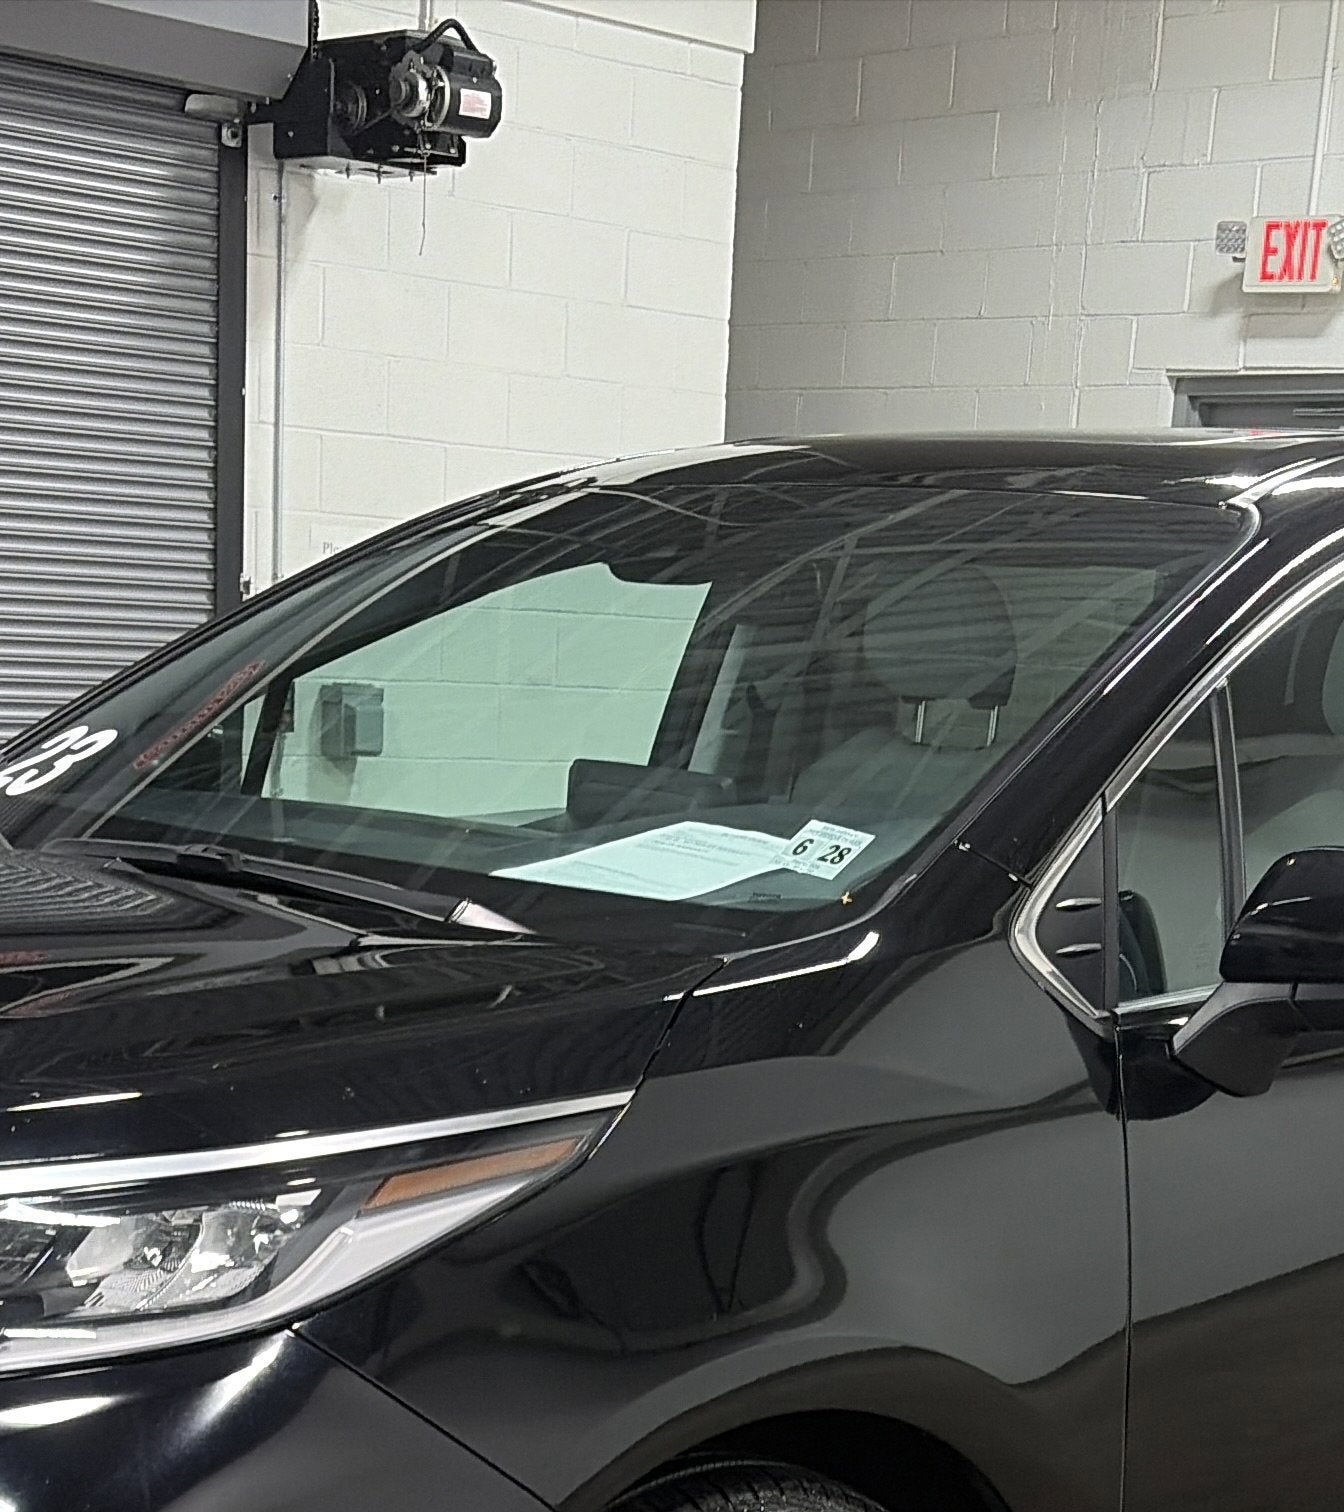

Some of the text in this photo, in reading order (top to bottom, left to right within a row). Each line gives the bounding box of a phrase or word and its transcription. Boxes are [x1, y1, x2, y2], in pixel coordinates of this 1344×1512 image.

[1260, 219, 1328, 281] EXIT
[792, 838, 815, 856] 6
[816, 844, 852, 865] 28
